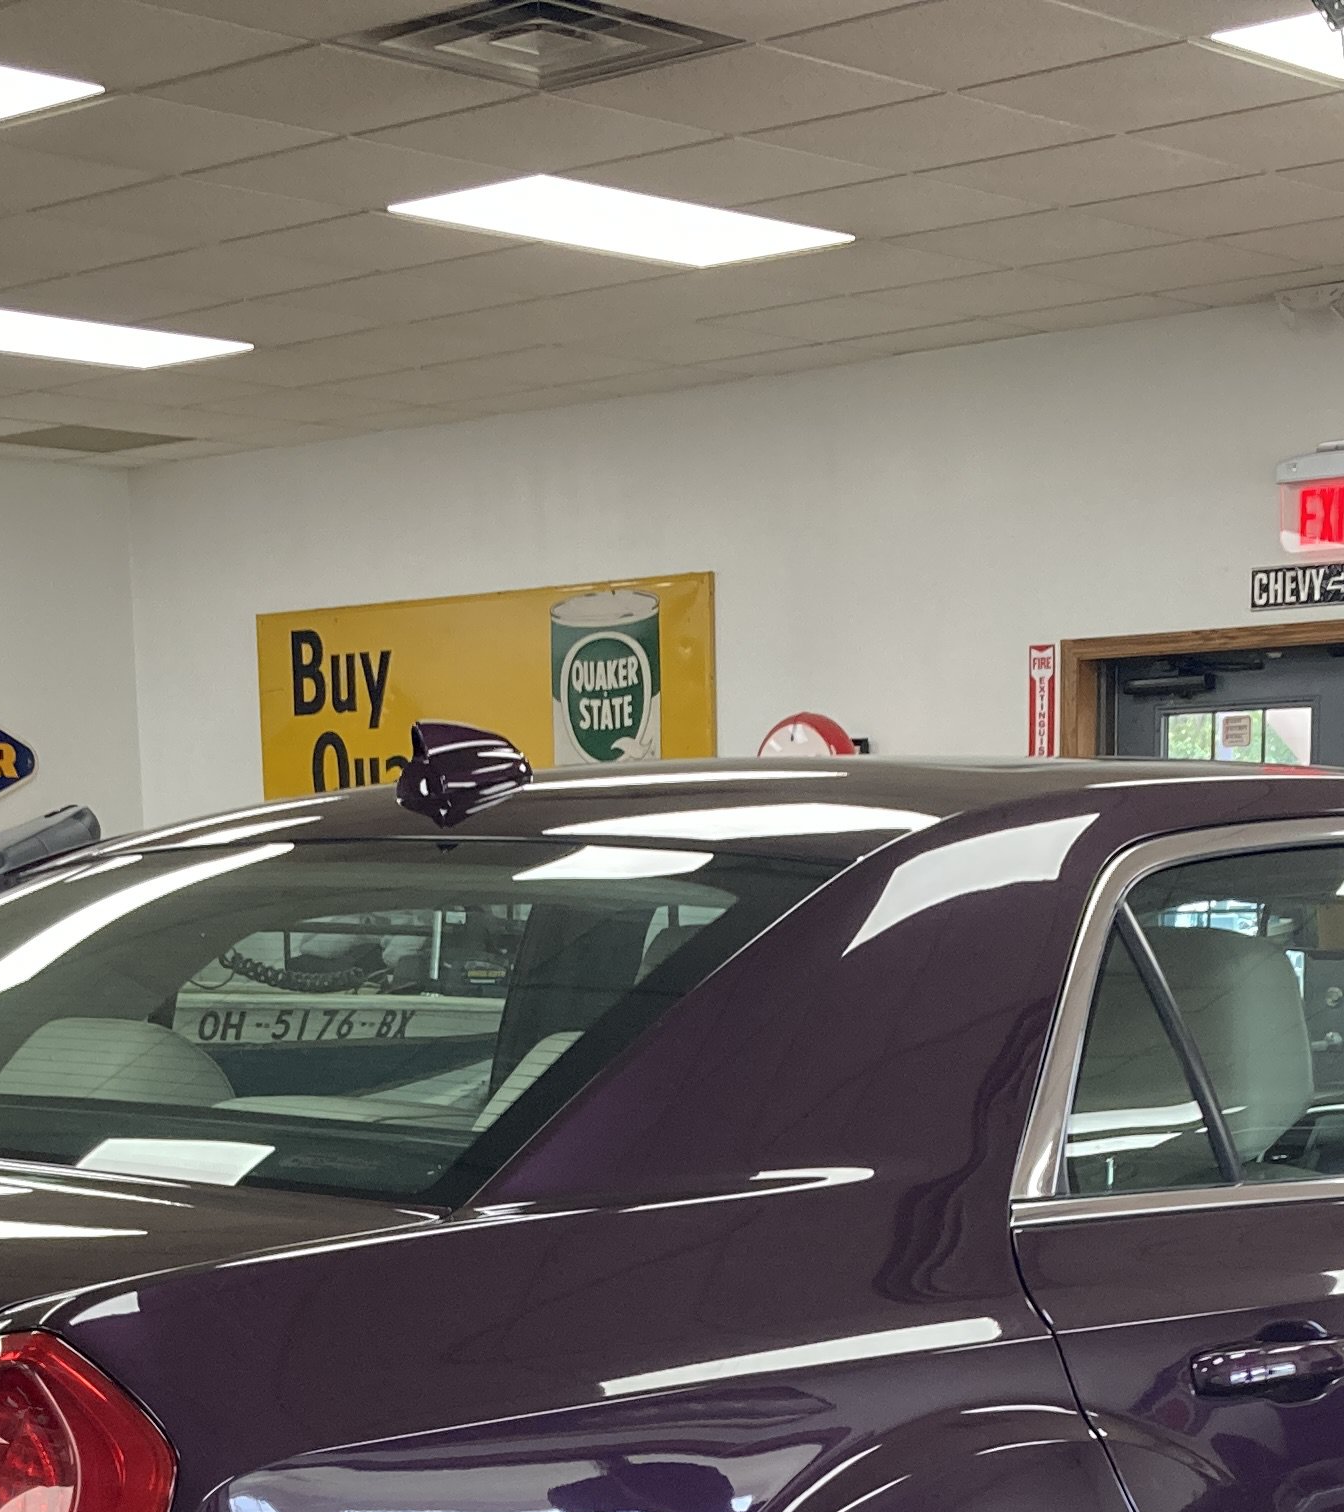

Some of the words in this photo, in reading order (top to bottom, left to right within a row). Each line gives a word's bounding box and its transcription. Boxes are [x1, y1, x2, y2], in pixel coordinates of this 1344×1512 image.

[1254, 568, 1326, 605] CHEVY
[291, 629, 392, 729] Buy
[571, 656, 639, 693] QUAKER
[1032, 658, 1051, 670] FIRE
[579, 695, 633, 730] STATE
